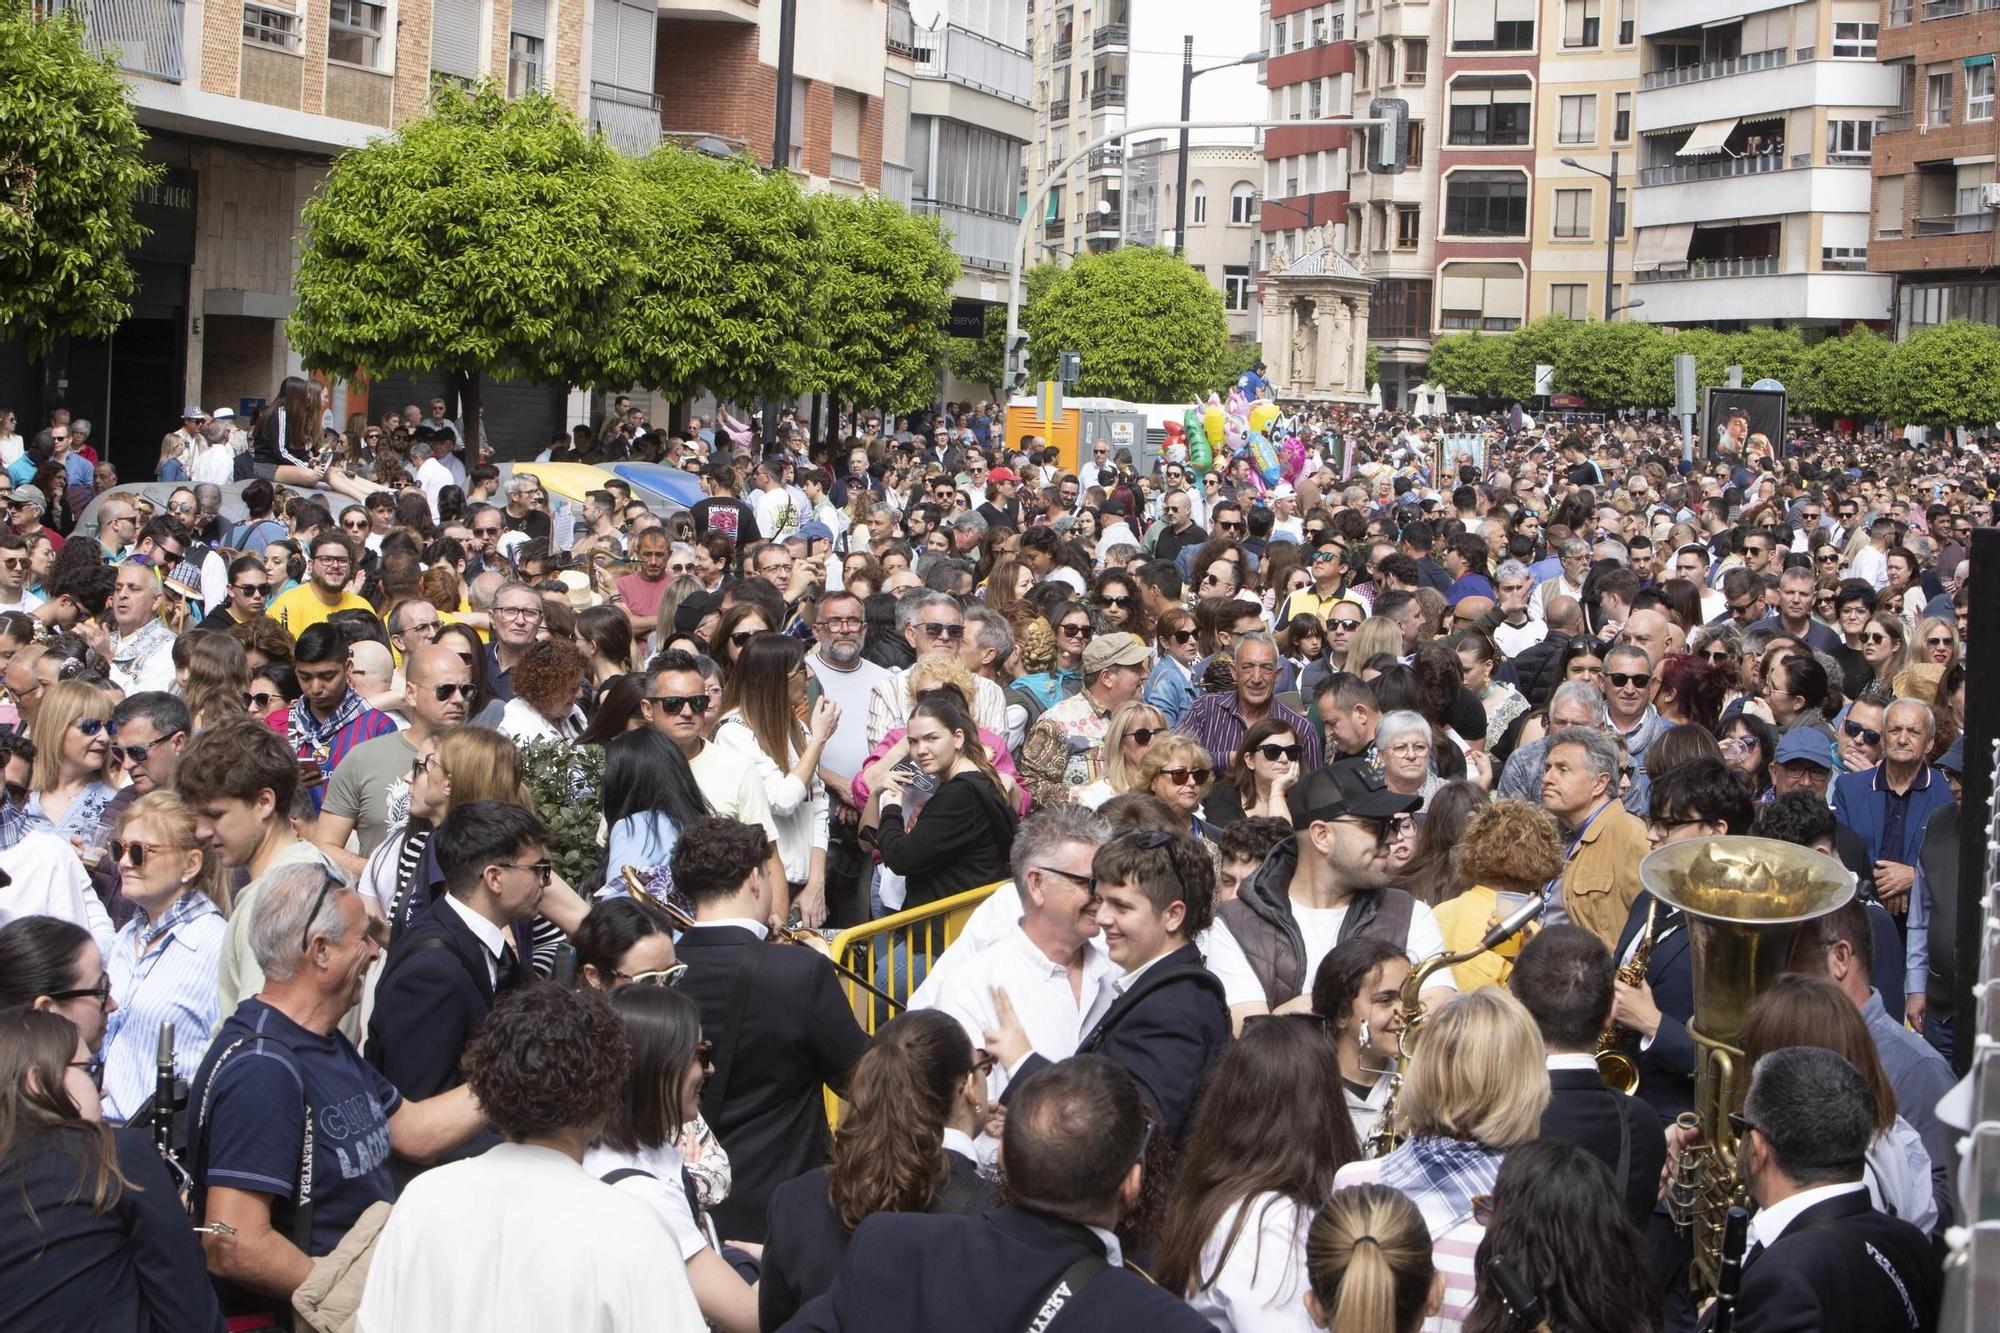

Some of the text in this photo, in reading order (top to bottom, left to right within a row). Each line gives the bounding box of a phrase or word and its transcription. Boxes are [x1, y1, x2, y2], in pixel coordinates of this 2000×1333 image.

[149, 184, 160, 204] DE
[164, 185, 192, 208] JUEGO
[953, 316, 981, 326] BBVA
[708, 506, 740, 517] DRAGON
[299, 1104, 314, 1207] A.M.SENYERA
